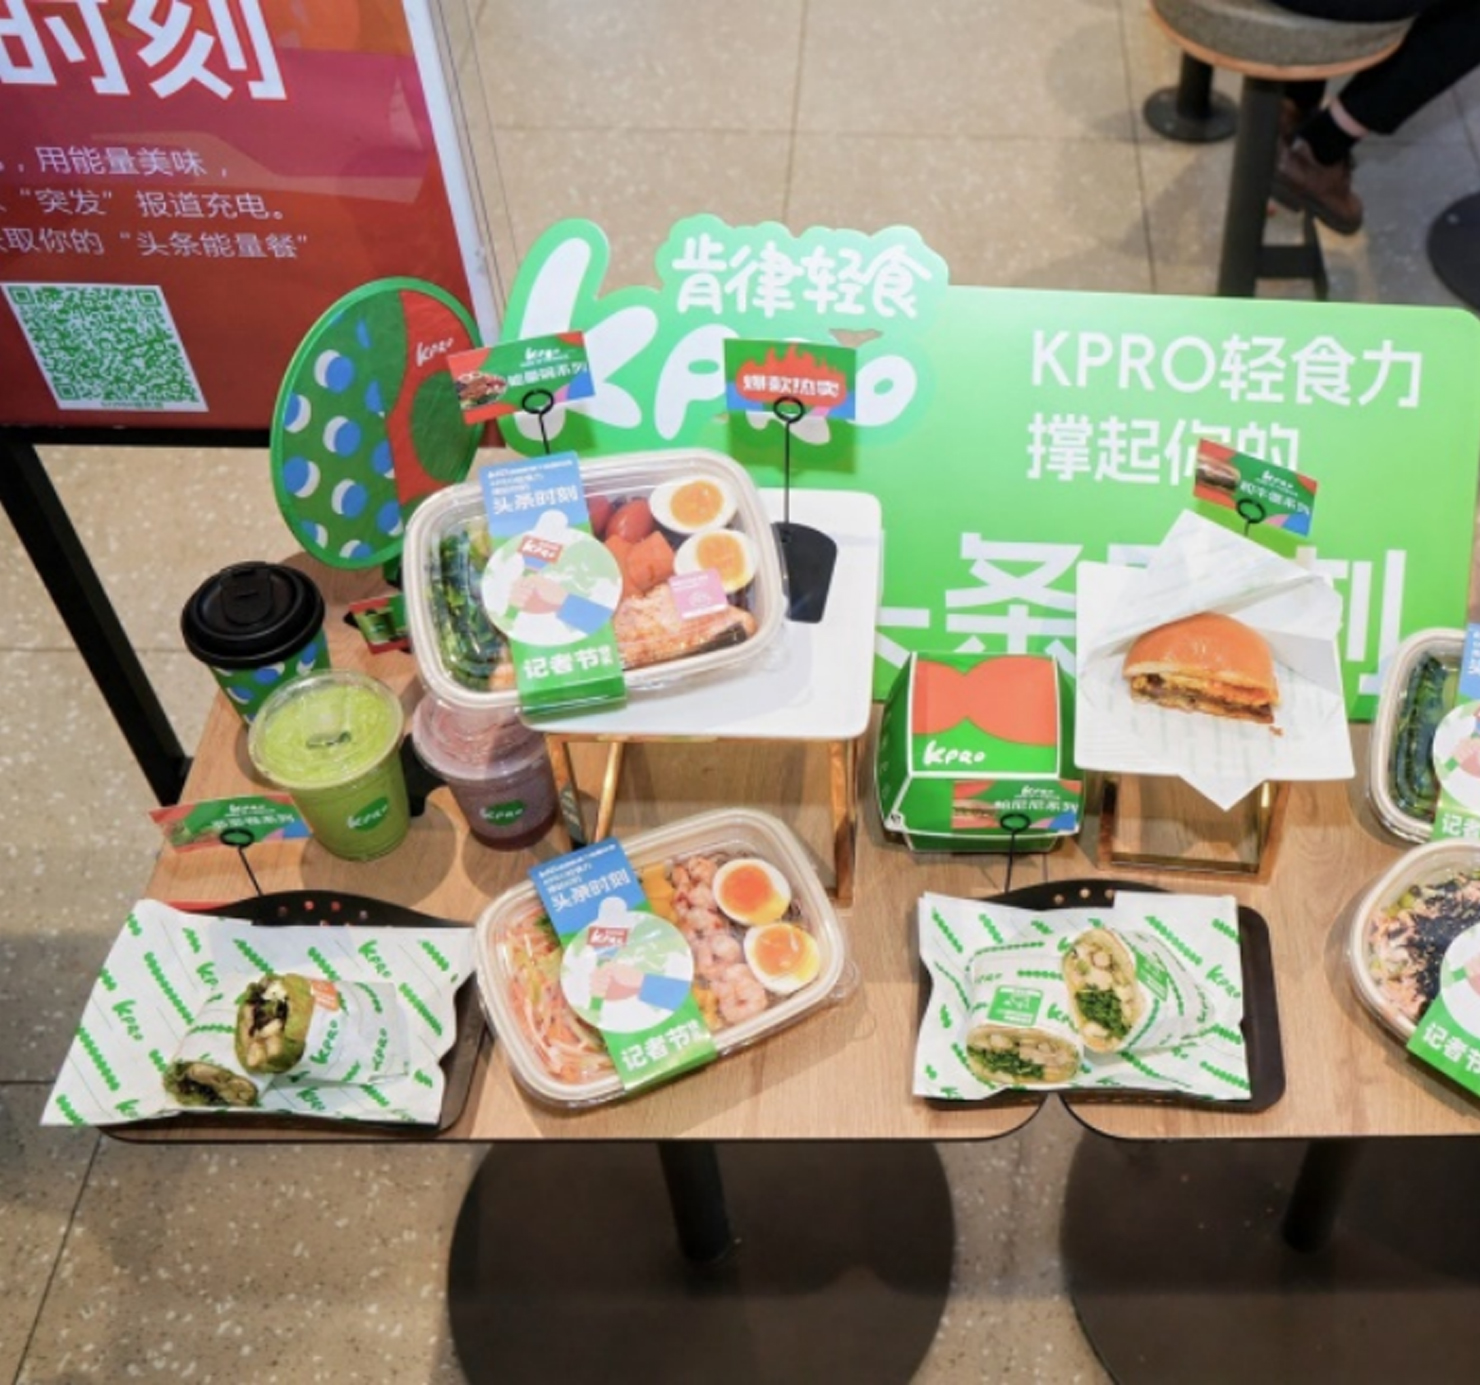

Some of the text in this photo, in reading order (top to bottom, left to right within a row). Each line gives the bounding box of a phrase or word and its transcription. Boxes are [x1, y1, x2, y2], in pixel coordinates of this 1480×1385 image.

[0, 146, 228, 178] ，用能量美味，
[0, 188, 284, 219] “突发”报道充电。
[0, 227, 308, 258] 取你的“头条能量餐”
[672, 234, 931, 319] 肯律轻食
[1031, 329, 1422, 408] KPRO轻食力
[743, 373, 841, 399] 爆款热卖
[923, 740, 986, 765] KPRO
